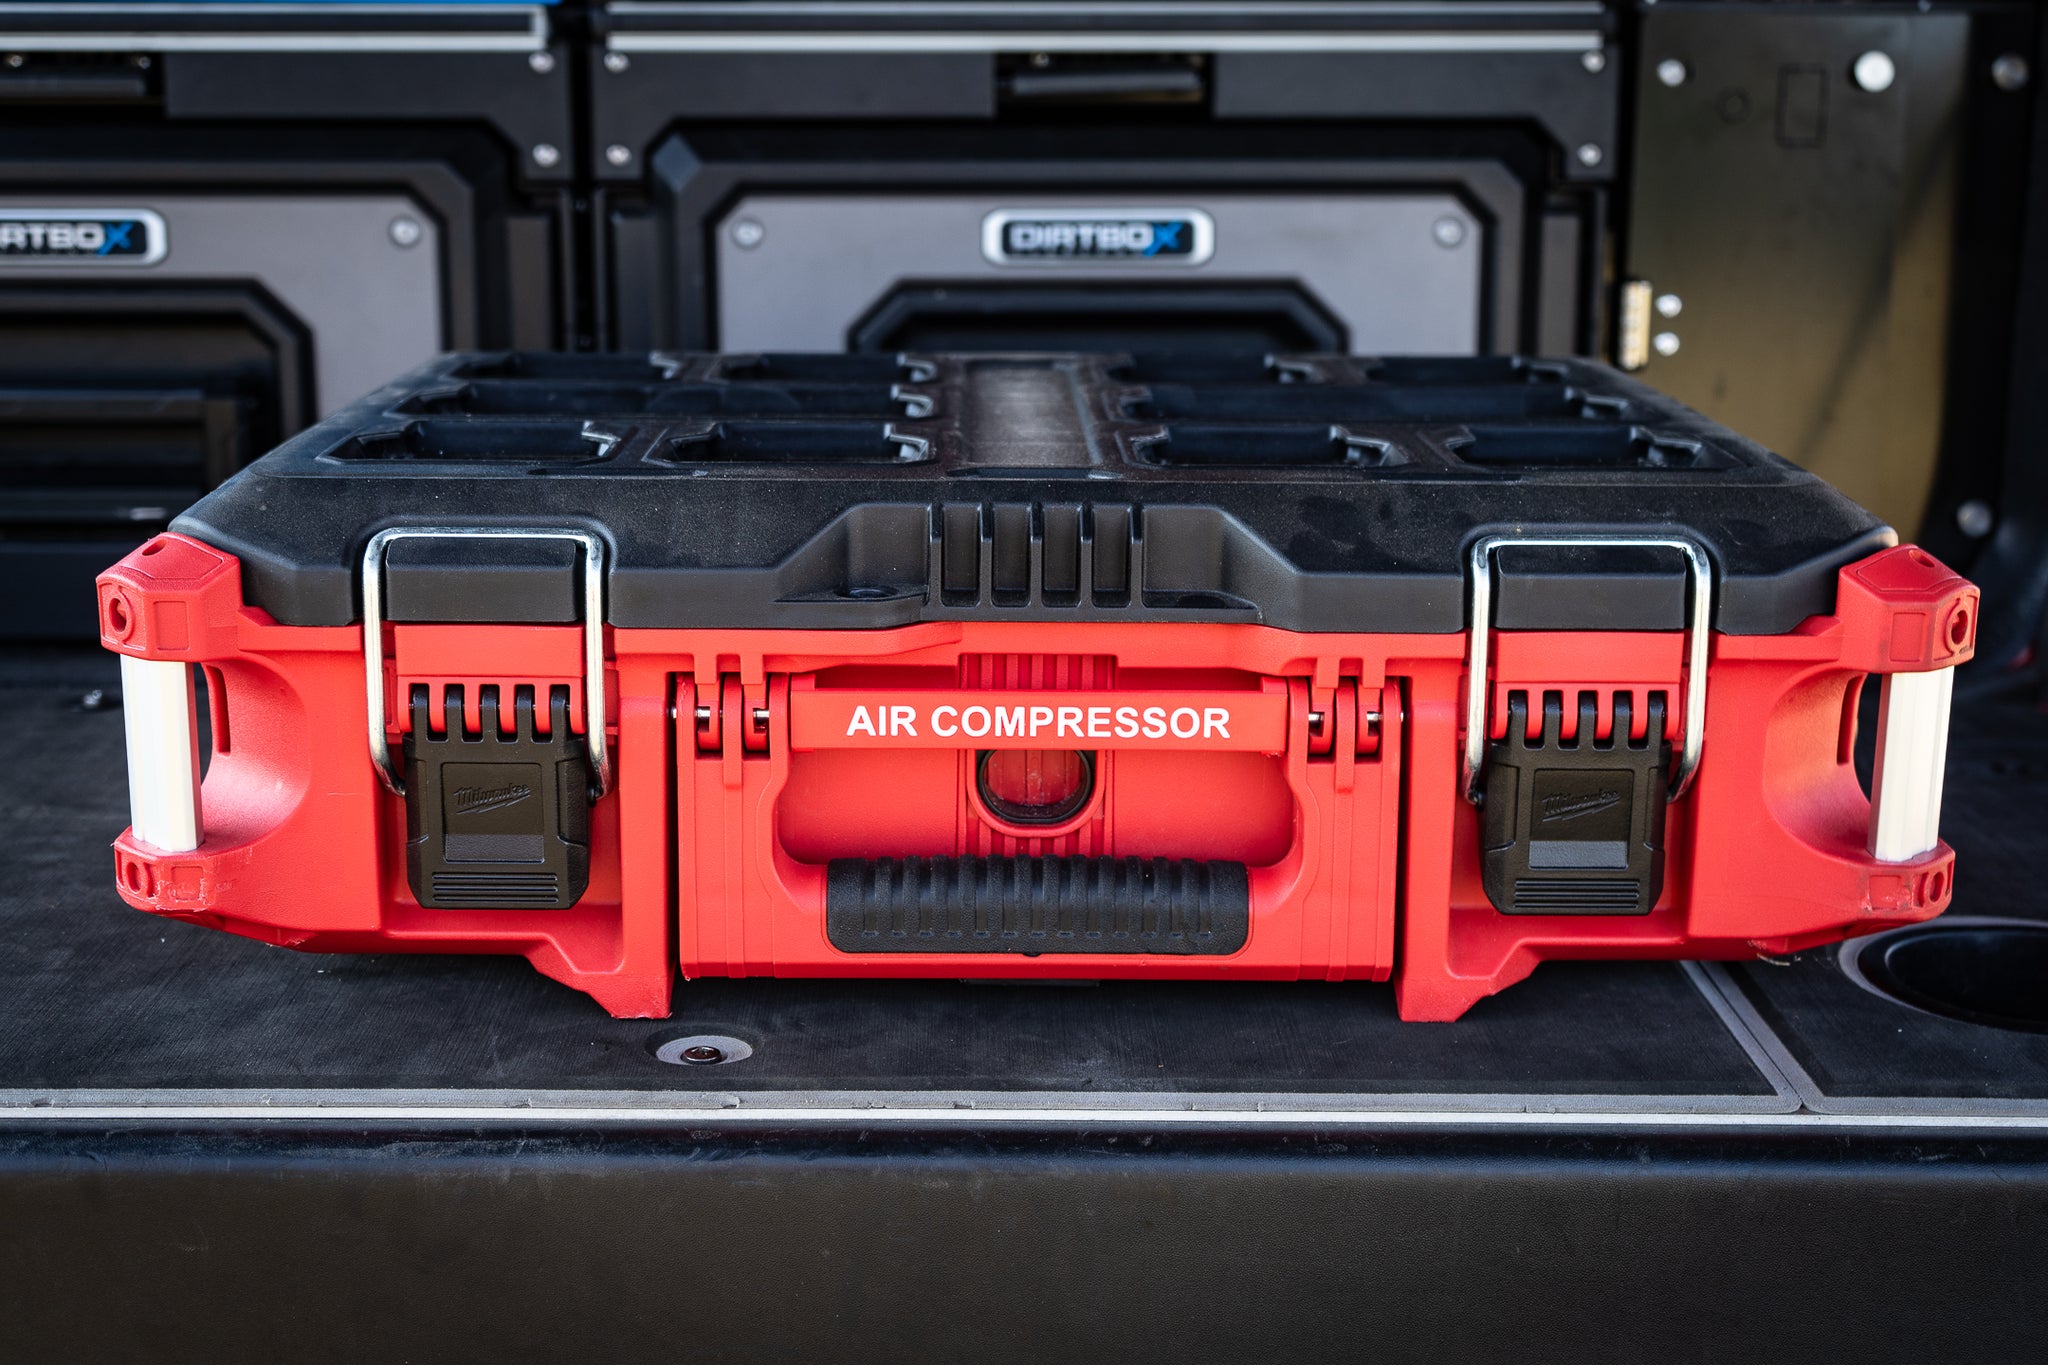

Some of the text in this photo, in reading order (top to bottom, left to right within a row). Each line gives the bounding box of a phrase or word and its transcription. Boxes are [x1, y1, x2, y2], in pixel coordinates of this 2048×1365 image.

[1009, 221, 1185, 257] DIRTBOX
[846, 705, 1231, 738] AIR COMPRESSOR
[452, 783, 531, 808] Milwaukee
